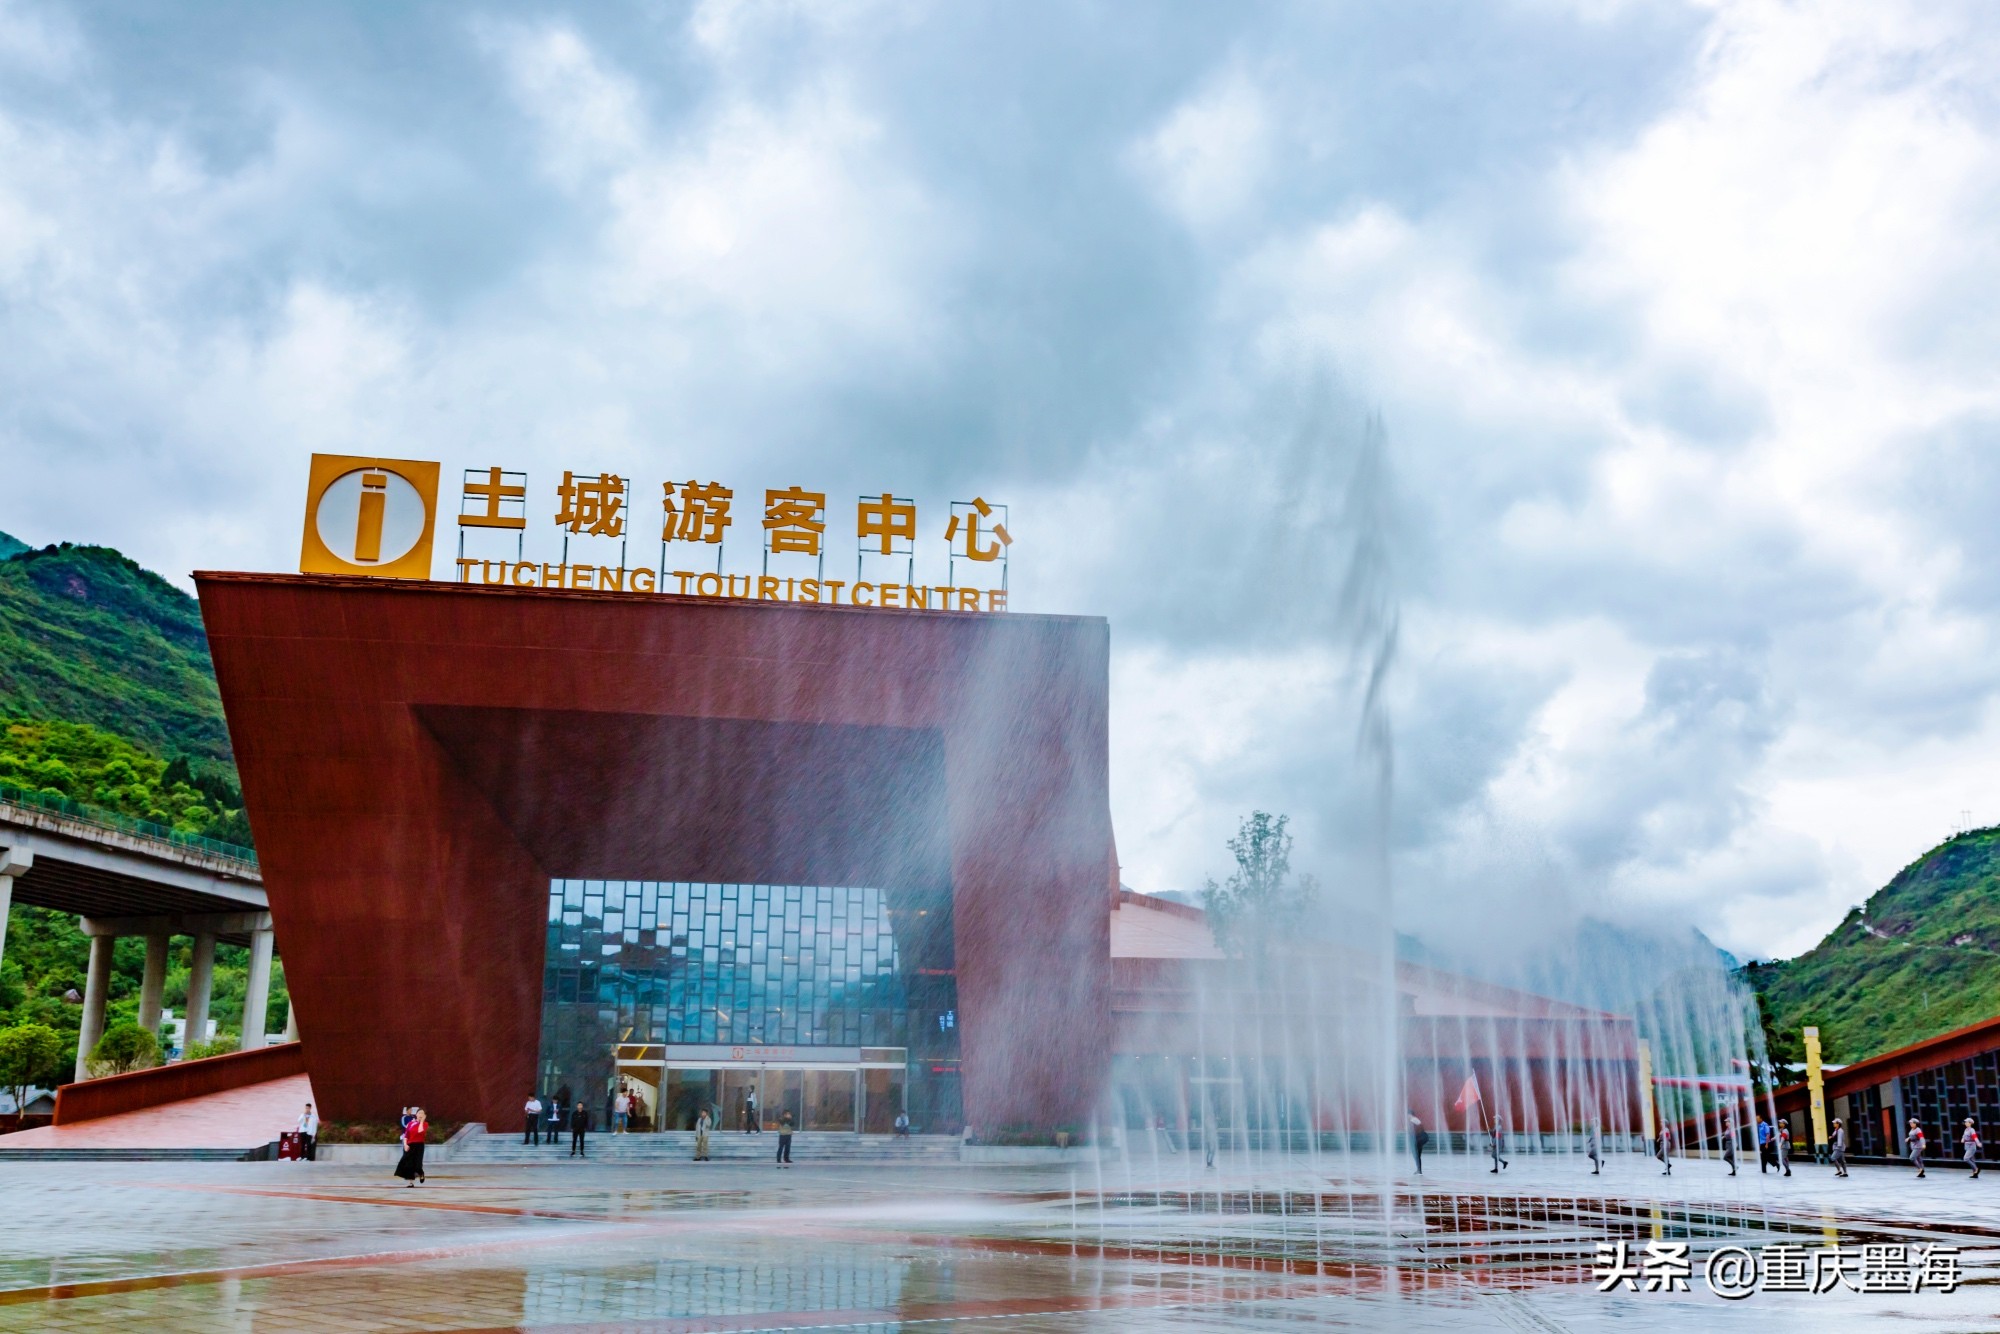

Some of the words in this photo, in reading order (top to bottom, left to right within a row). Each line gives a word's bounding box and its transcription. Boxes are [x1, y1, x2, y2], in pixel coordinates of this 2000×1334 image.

[458, 467, 1013, 562] 土城游客中心
[456, 558, 655, 593] TUCHENG
